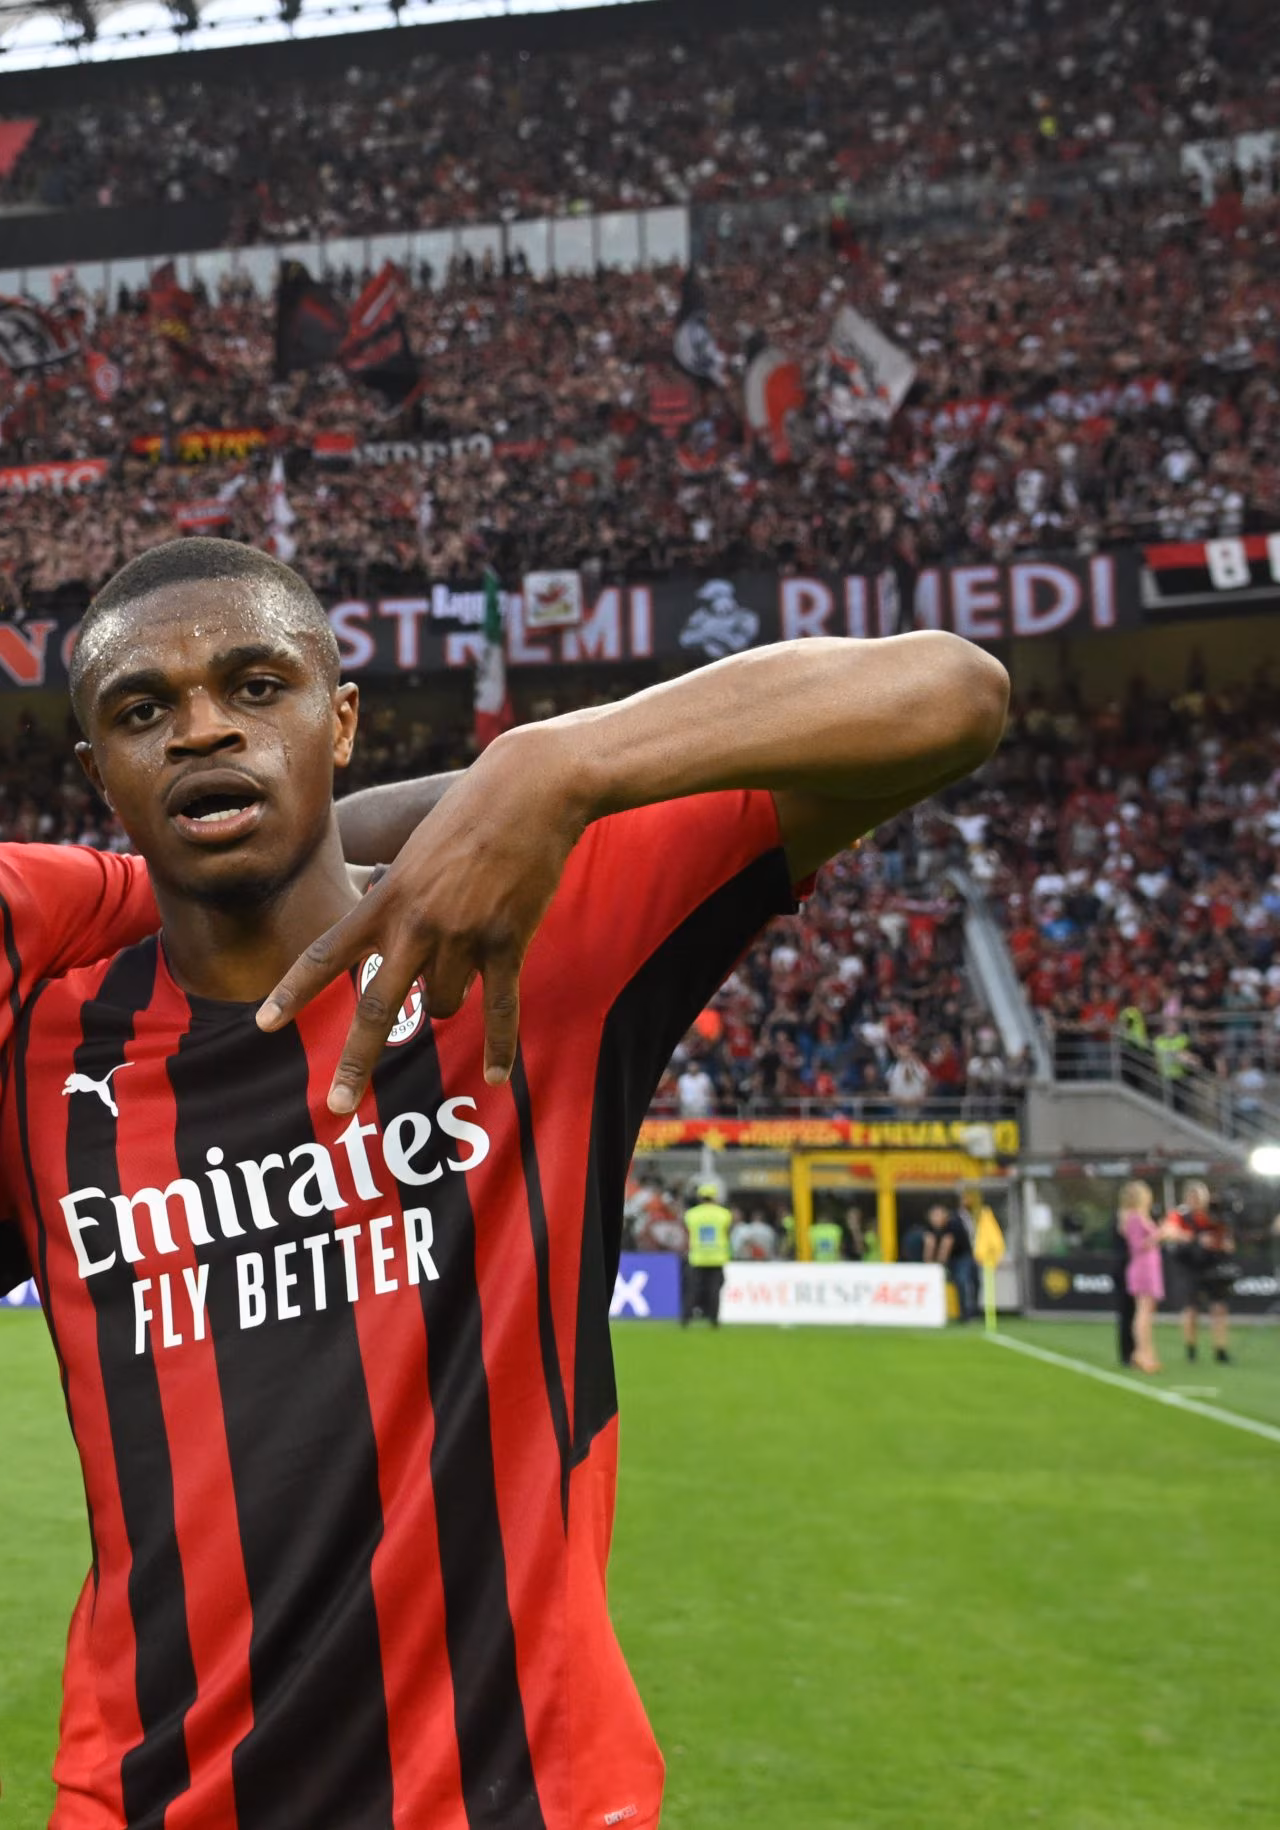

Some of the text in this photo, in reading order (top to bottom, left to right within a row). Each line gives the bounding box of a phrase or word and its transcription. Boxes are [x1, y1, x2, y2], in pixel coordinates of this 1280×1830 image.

[366, 954, 383, 980] AC
[390, 1020, 416, 1038] 899
[59, 1095, 490, 1280] Emirates
[132, 1207, 441, 1355] FLY BETTER
